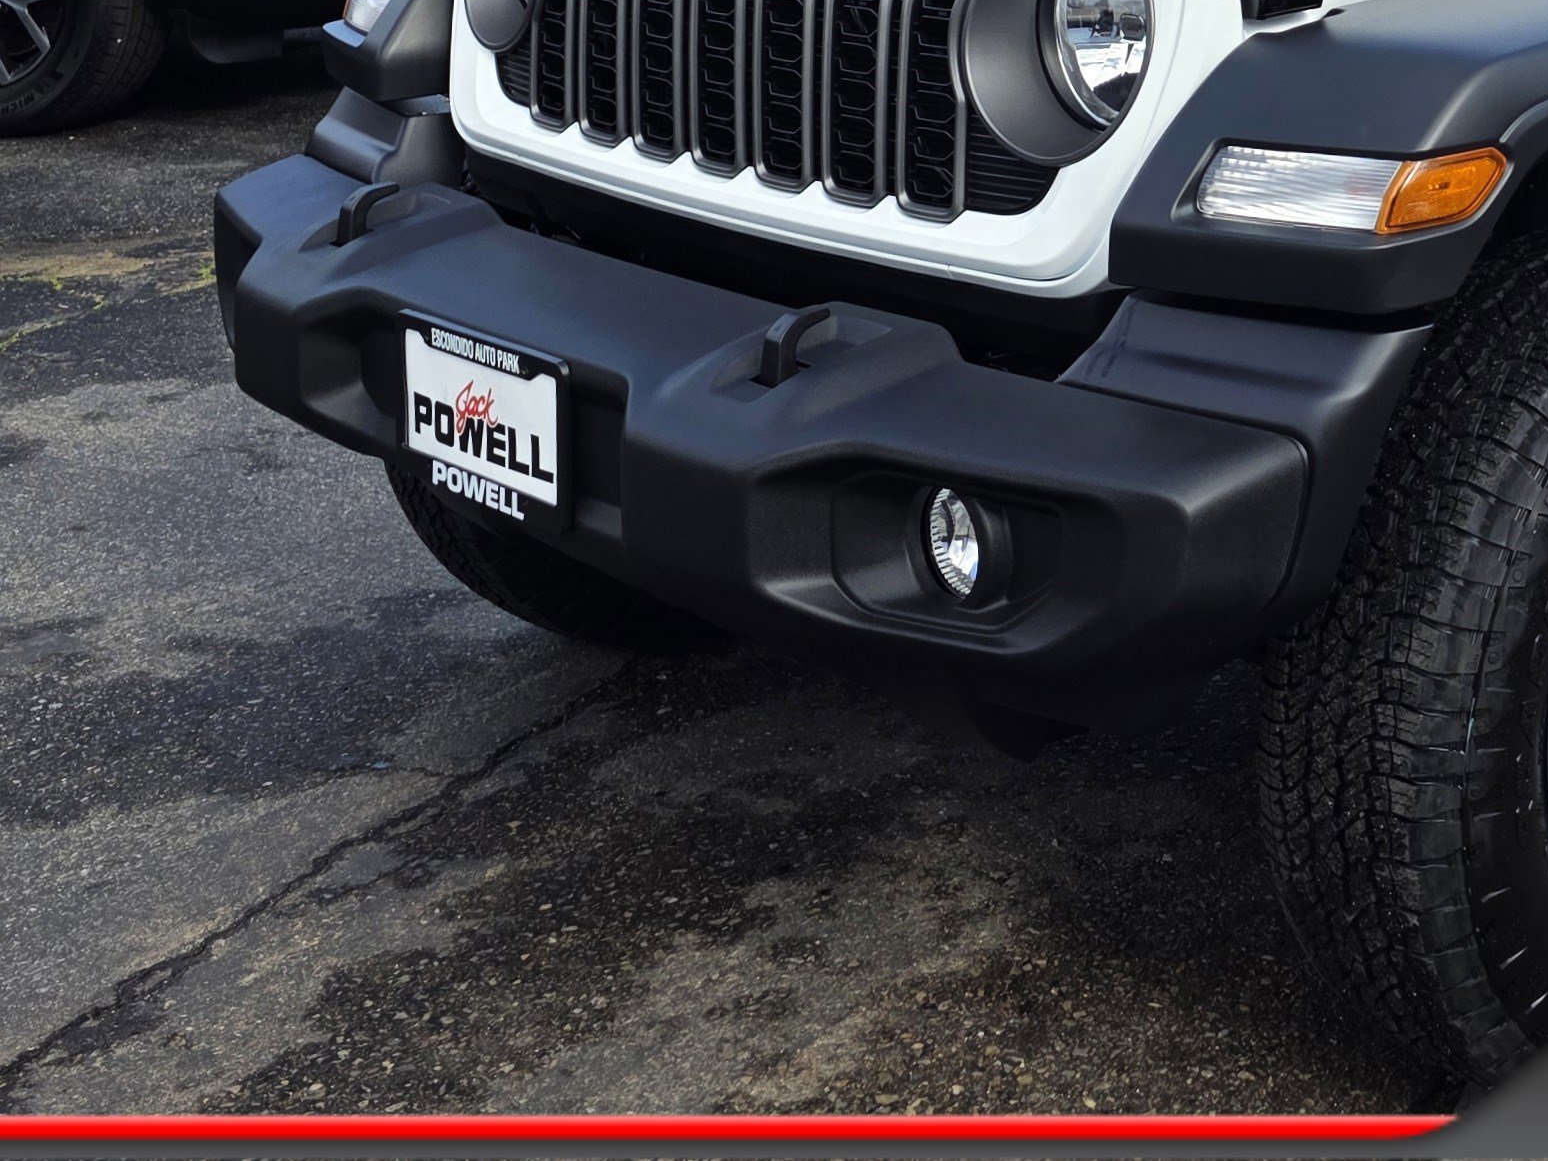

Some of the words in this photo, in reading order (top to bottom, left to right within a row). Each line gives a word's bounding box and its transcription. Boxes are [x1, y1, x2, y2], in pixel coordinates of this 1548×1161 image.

[431, 327, 473, 358] ESCONDIDO
[475, 343, 496, 366] AUTO
[497, 350, 520, 375] PARK
[455, 379, 499, 436] Jack
[413, 391, 555, 484] POWELL
[431, 459, 525, 521] POWELL
